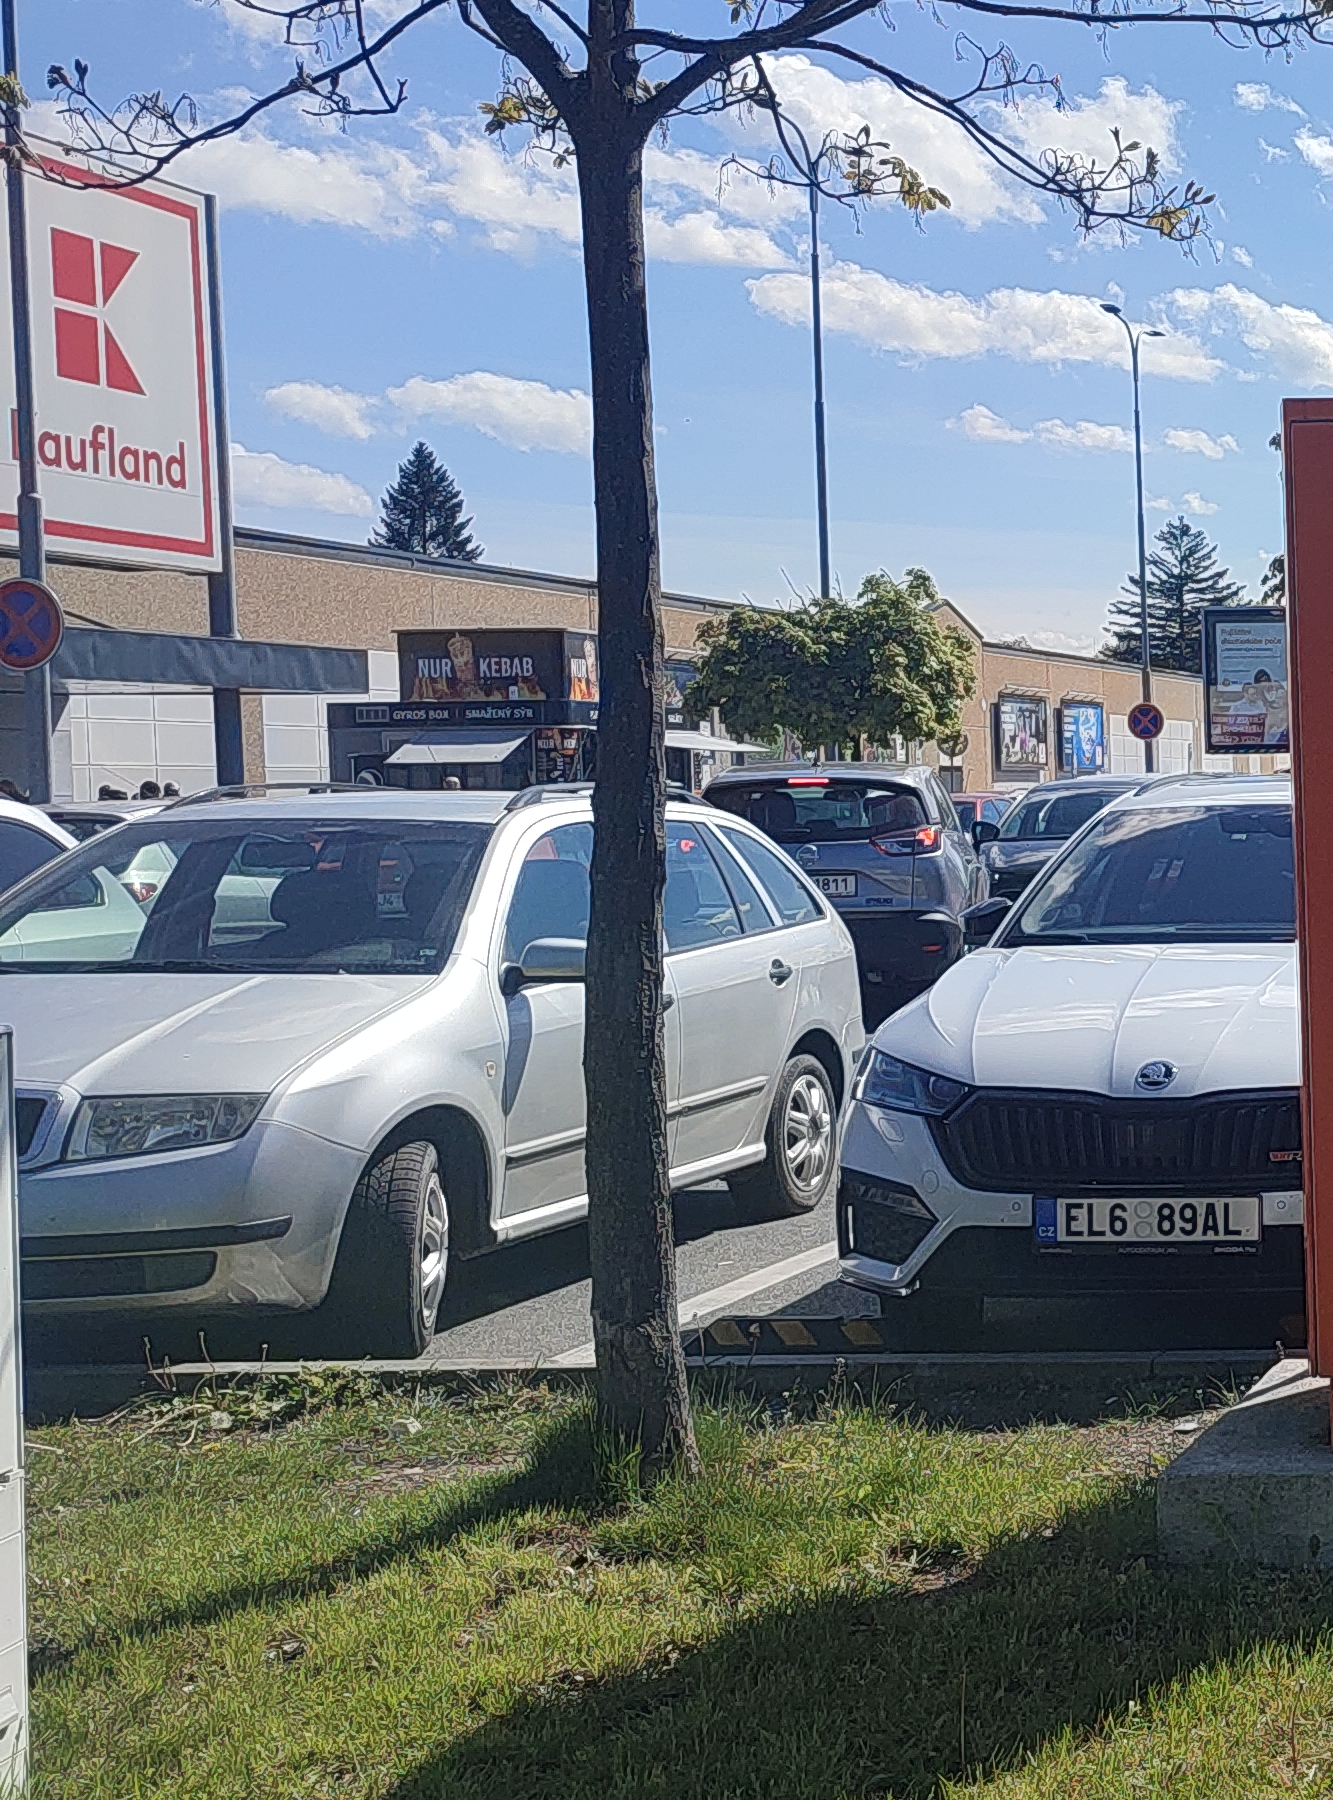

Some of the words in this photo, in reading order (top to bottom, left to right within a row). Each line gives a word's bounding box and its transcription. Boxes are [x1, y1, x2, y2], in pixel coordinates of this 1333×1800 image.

[416, 658, 453, 679] NUR
[479, 656, 534, 678] KEBAB
[392, 710, 427, 720] GYROS
[428, 710, 450, 720] BOX
[1064, 1202, 1128, 1237] EL6
[1156, 1202, 1243, 1237] 89AL
[1038, 1226, 1055, 1237] CZ
